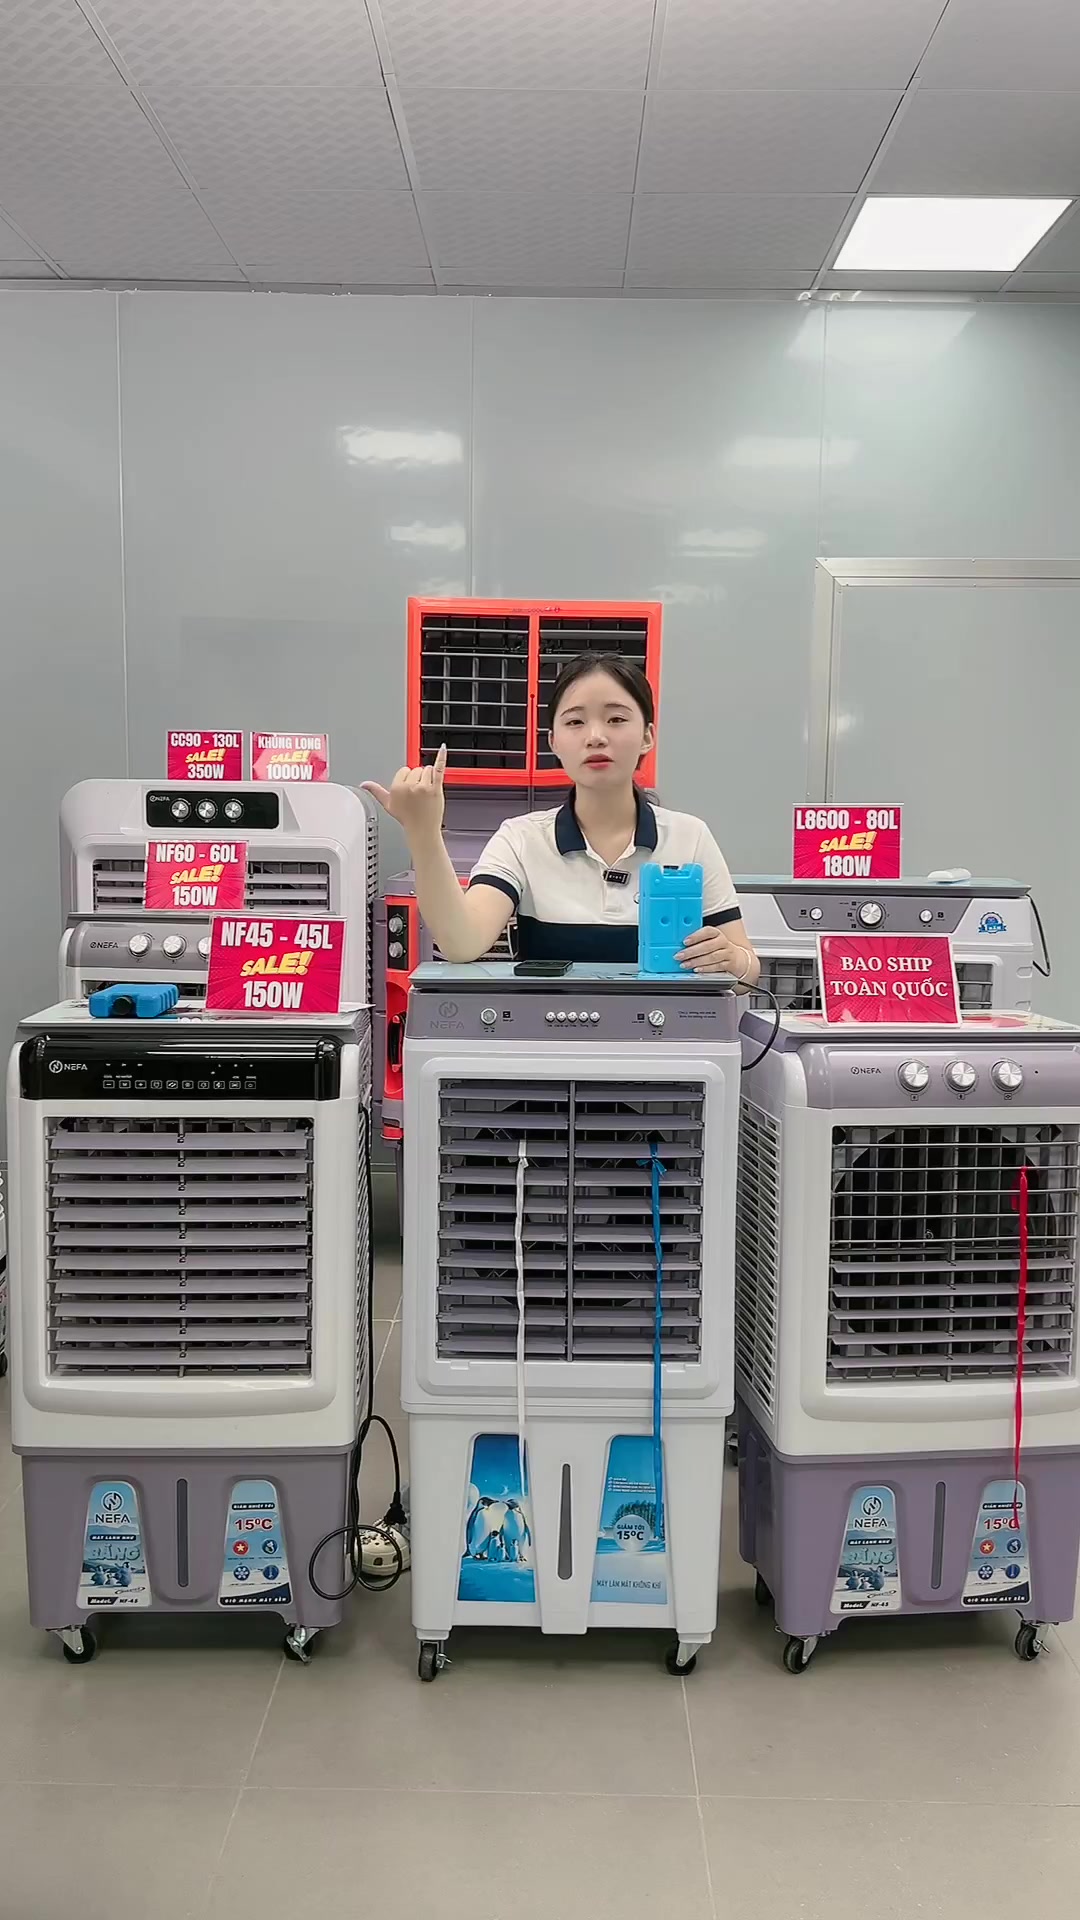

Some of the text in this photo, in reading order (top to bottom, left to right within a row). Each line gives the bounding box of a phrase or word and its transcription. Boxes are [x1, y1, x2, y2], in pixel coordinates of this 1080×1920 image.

[171, 733, 200, 747] CC90
[213, 733, 239, 748] 130L
[295, 737, 321, 750] LONG
[185, 748, 226, 763] SALE!
[270, 750, 310, 764] SALE!
[187, 764, 224, 779] 350W
[266, 764, 313, 780] 1000W
[795, 809, 849, 830] L8600
[866, 809, 898, 830] 80L
[818, 831, 877, 853] SALE!
[156, 843, 195, 863] NF60
[210, 844, 239, 863] 60L
[822, 855, 872, 877] 180W
[169, 864, 224, 885] SALE!
[172, 885, 218, 906] 150W
[220, 921, 274, 947] NF45
[293, 923, 333, 950] 45L
[96, 941, 119, 949] NEFA
[239, 951, 315, 976] SALE!
[840, 956, 933, 973] BAO SHIP
[242, 981, 304, 1009] 150W
[830, 977, 949, 1000] TOÀN QUỐC
[430, 1020, 465, 1029] NEFA
[63, 1063, 88, 1071] NEFA
[95, 1513, 130, 1523] NEFA
[854, 1518, 887, 1528] NEFA
